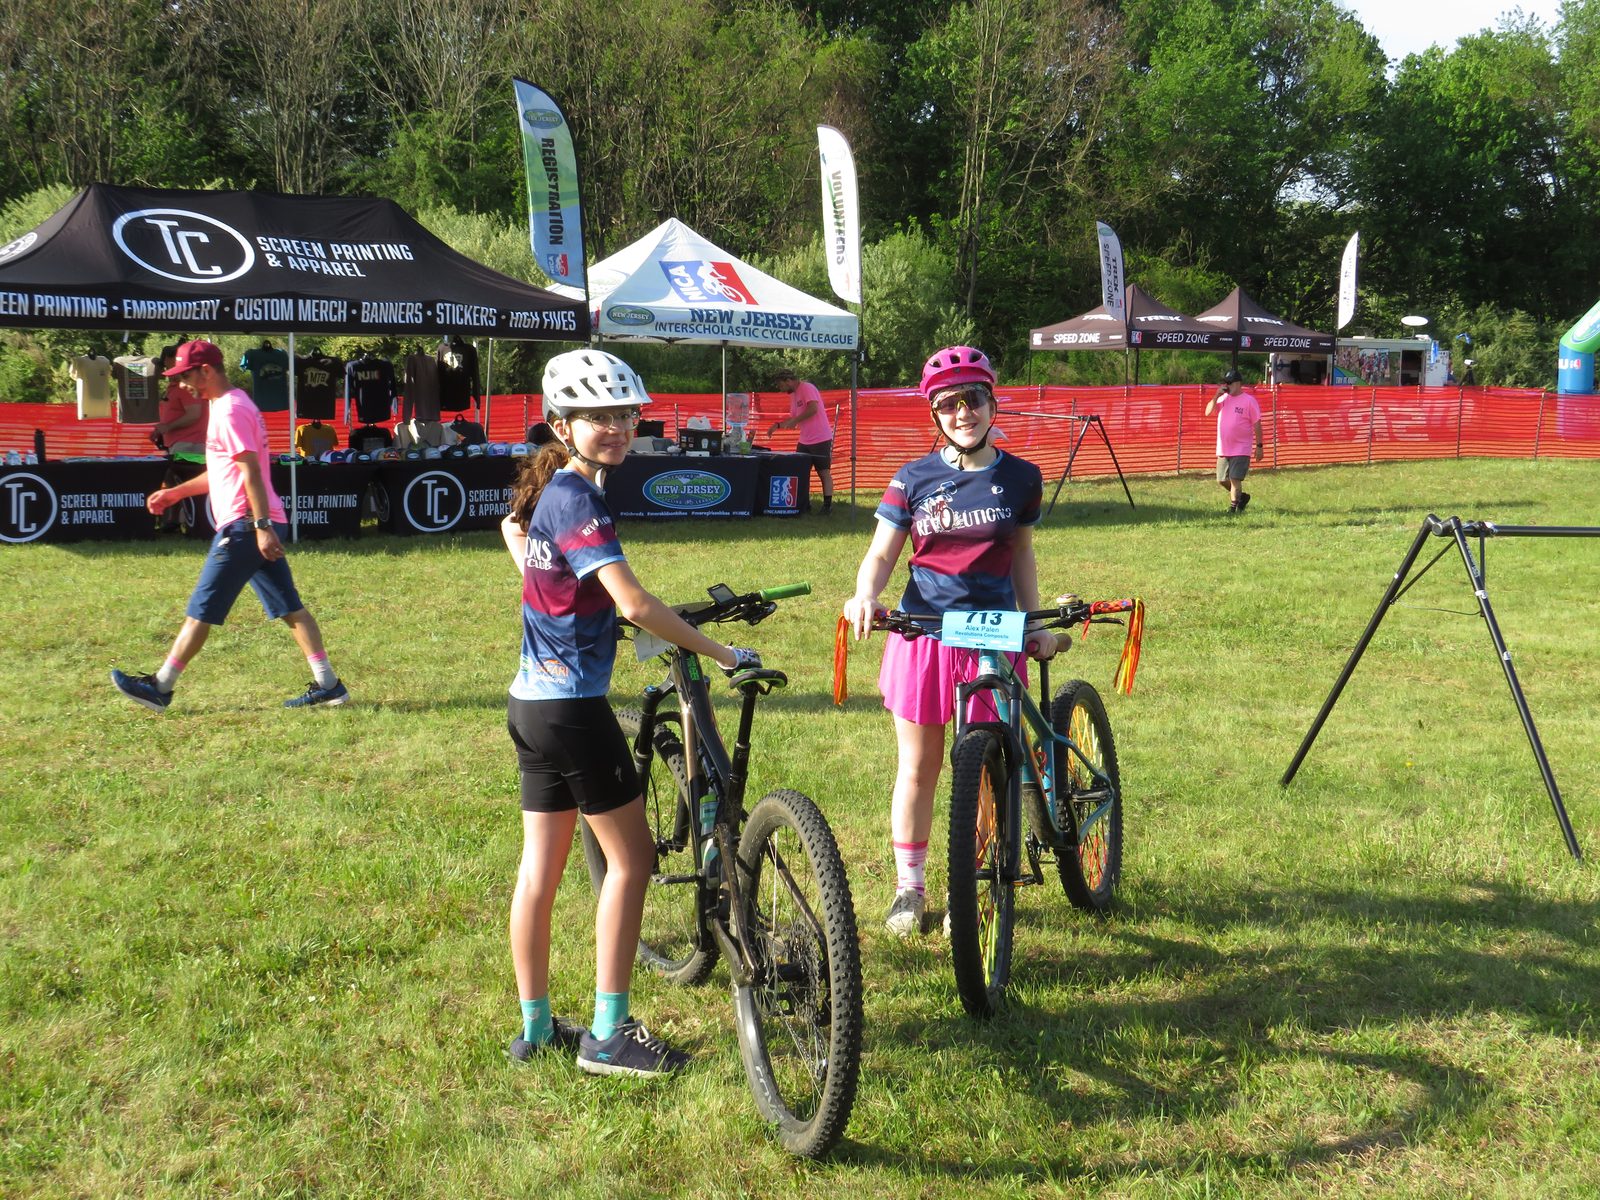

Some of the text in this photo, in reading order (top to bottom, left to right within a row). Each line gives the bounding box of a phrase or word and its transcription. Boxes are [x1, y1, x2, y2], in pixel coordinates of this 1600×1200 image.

[541, 138, 564, 245] REGISTRATION
[144, 218, 223, 275] TC
[256, 236, 415, 261] SCREEN PRINTING
[267, 253, 366, 277] & APPAREL
[668, 265, 708, 301] NICA
[33, 294, 108, 319] PRINTING
[123, 300, 221, 321] EMBROIDERY
[235, 298, 294, 321] CUSTOM
[298, 299, 348, 322] MERCH
[361, 302, 423, 324] BANNERS
[436, 303, 497, 326] STICKERS
[509, 310, 540, 329] HIGH
[543, 311, 577, 331] FIVES
[626, 312, 650, 320] JERSEY
[689, 308, 814, 331] NEW JERSEY
[655, 321, 853, 345] INTERSCHOLASTIC CYCLING LEAGUE
[1053, 332, 1100, 344] SPEED ZONE
[1156, 332, 1184, 343] SPEED
[1185, 333, 1210, 344] ZONE
[1263, 337, 1288, 347] SPEED
[1289, 338, 1311, 348] ZONE
[469, 489, 500, 502] SCREEN
[655, 485, 720, 494] NEW JERSEY
[772, 479, 781, 504] NICA
[5, 483, 38, 533] TC
[60, 493, 145, 509] SCREEN PRINTING
[280, 494, 358, 510] SCEEN PRINTING
[422, 480, 449, 524] TC
[469, 504, 476, 517] &
[61, 510, 116, 525] & APPAREL
[965, 612, 1003, 625] 713
